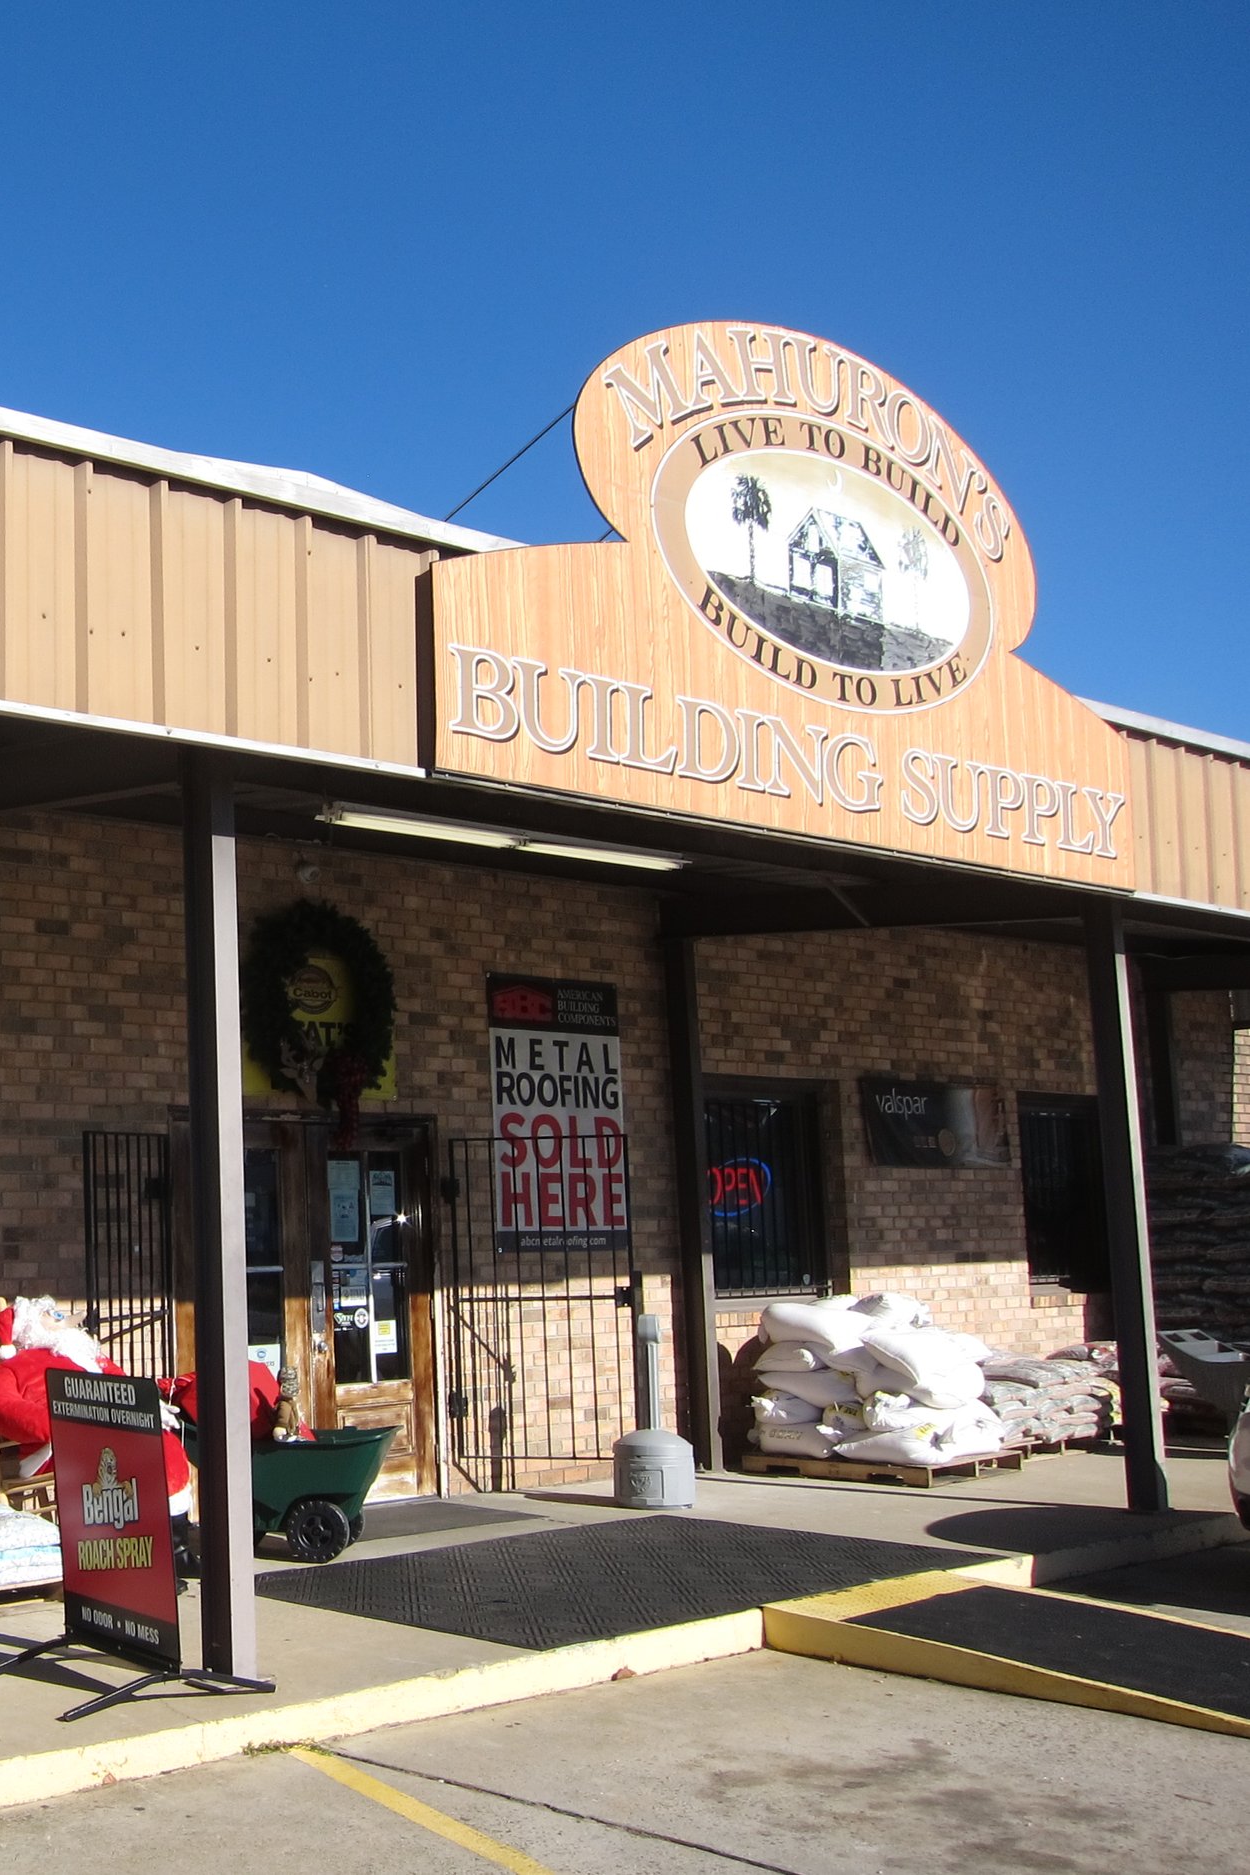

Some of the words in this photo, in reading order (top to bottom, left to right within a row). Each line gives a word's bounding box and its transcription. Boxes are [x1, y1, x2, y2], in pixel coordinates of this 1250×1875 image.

[602, 326, 1011, 562] MAHURON'S
[691, 416, 787, 469] LIVE
[799, 413, 847, 459] TO
[860, 440, 963, 547] BUILD
[699, 586, 817, 690] BUILD
[832, 675, 878, 707] TO
[890, 654, 968, 707] LIVE
[448, 643, 883, 813] BUILDING
[901, 748, 1125, 859] SUPPLY
[293, 987, 333, 1000] Cabot
[557, 988, 603, 1001] AMERICAN
[557, 1000, 600, 1013] BUILDING
[557, 1012, 616, 1027] COMPONENTS
[495, 1035, 618, 1075] METAL
[496, 1071, 619, 1110] ROOFING
[875, 1088, 929, 1120] valspar
[500, 1112, 622, 1169] SOLD
[501, 1172, 625, 1227] HERE
[64, 1376, 136, 1406] GUARANTEED
[53, 1400, 110, 1422] EXTERMINATION
[111, 1408, 154, 1428] OVERNIGHT
[82, 1477, 139, 1530] Bengal
[78, 1538, 115, 1571] ROACH
[116, 1536, 153, 1569] SPRAY
[81, 1605, 92, 1621] NO
[93, 1609, 114, 1630] ODOR
[125, 1619, 136, 1638] NO
[137, 1623, 160, 1645] MESS
